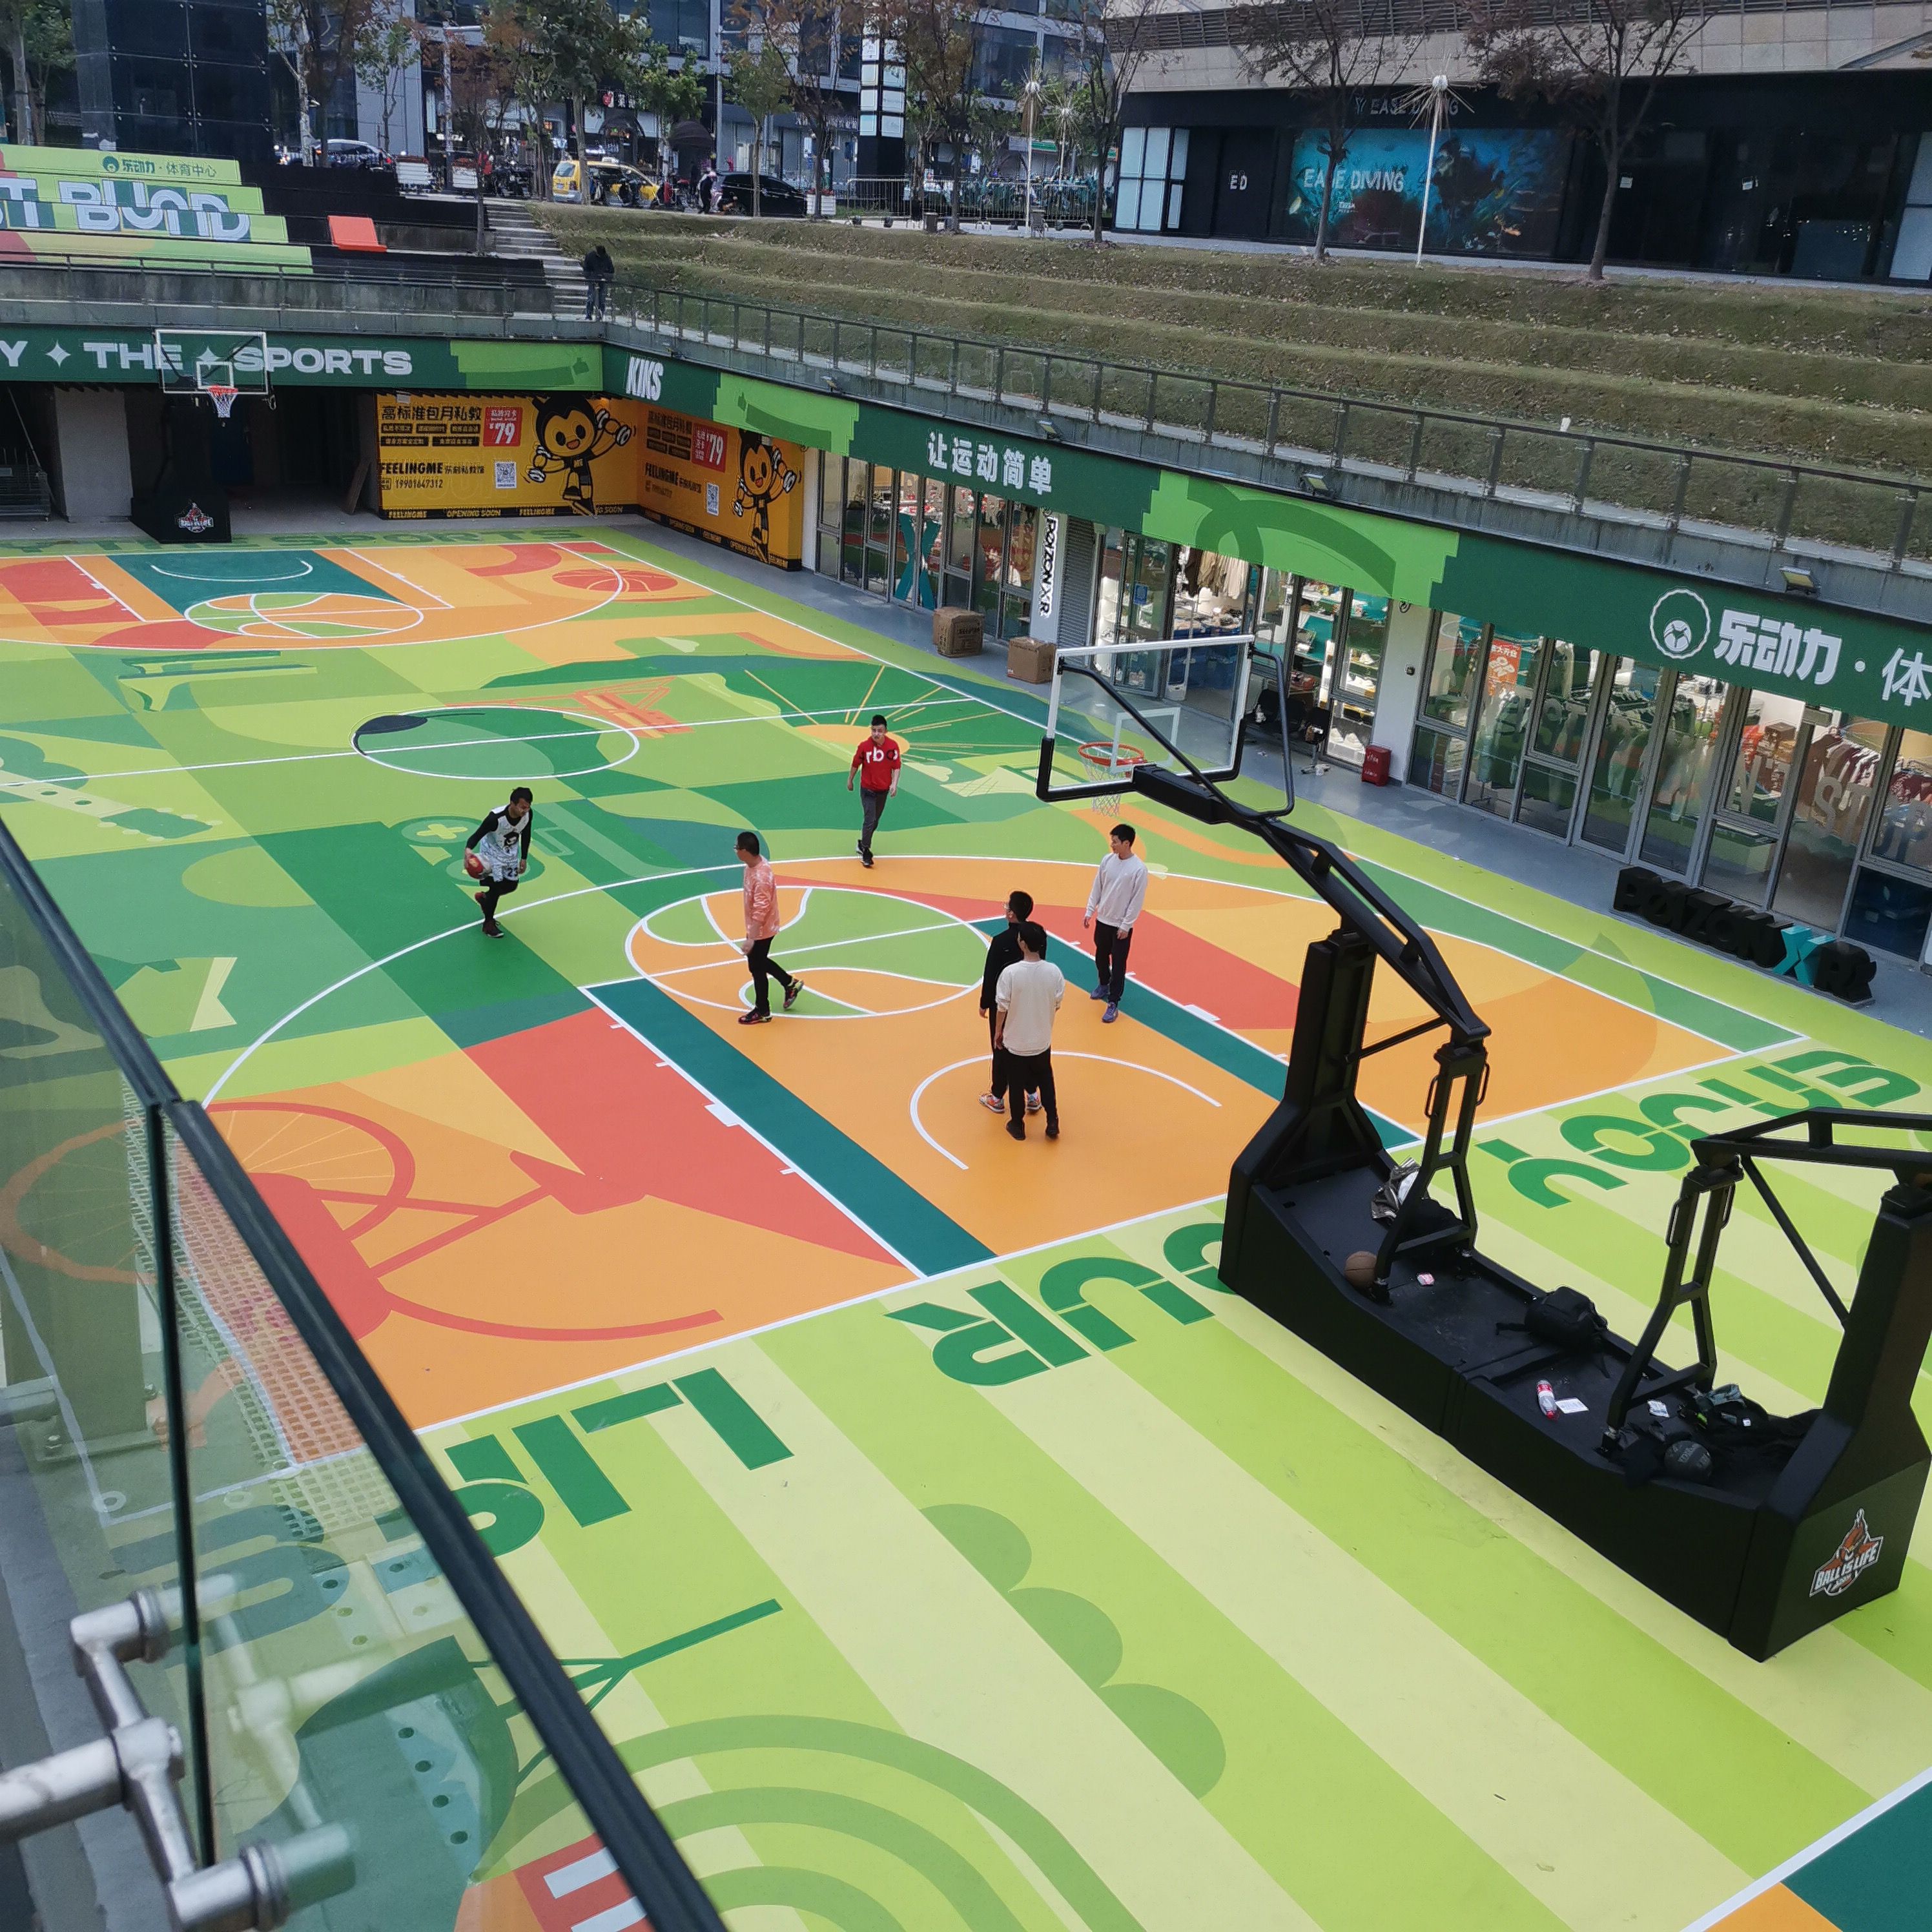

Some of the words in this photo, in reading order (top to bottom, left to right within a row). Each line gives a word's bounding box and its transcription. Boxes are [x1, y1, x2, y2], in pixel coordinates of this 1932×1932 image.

[1304, 169, 1347, 189] EAE
[1351, 170, 1404, 192] DIVING
[84, 342, 184, 369] THE
[232, 346, 413, 376] SPORTS
[927, 431, 1052, 495] 让运动简单
